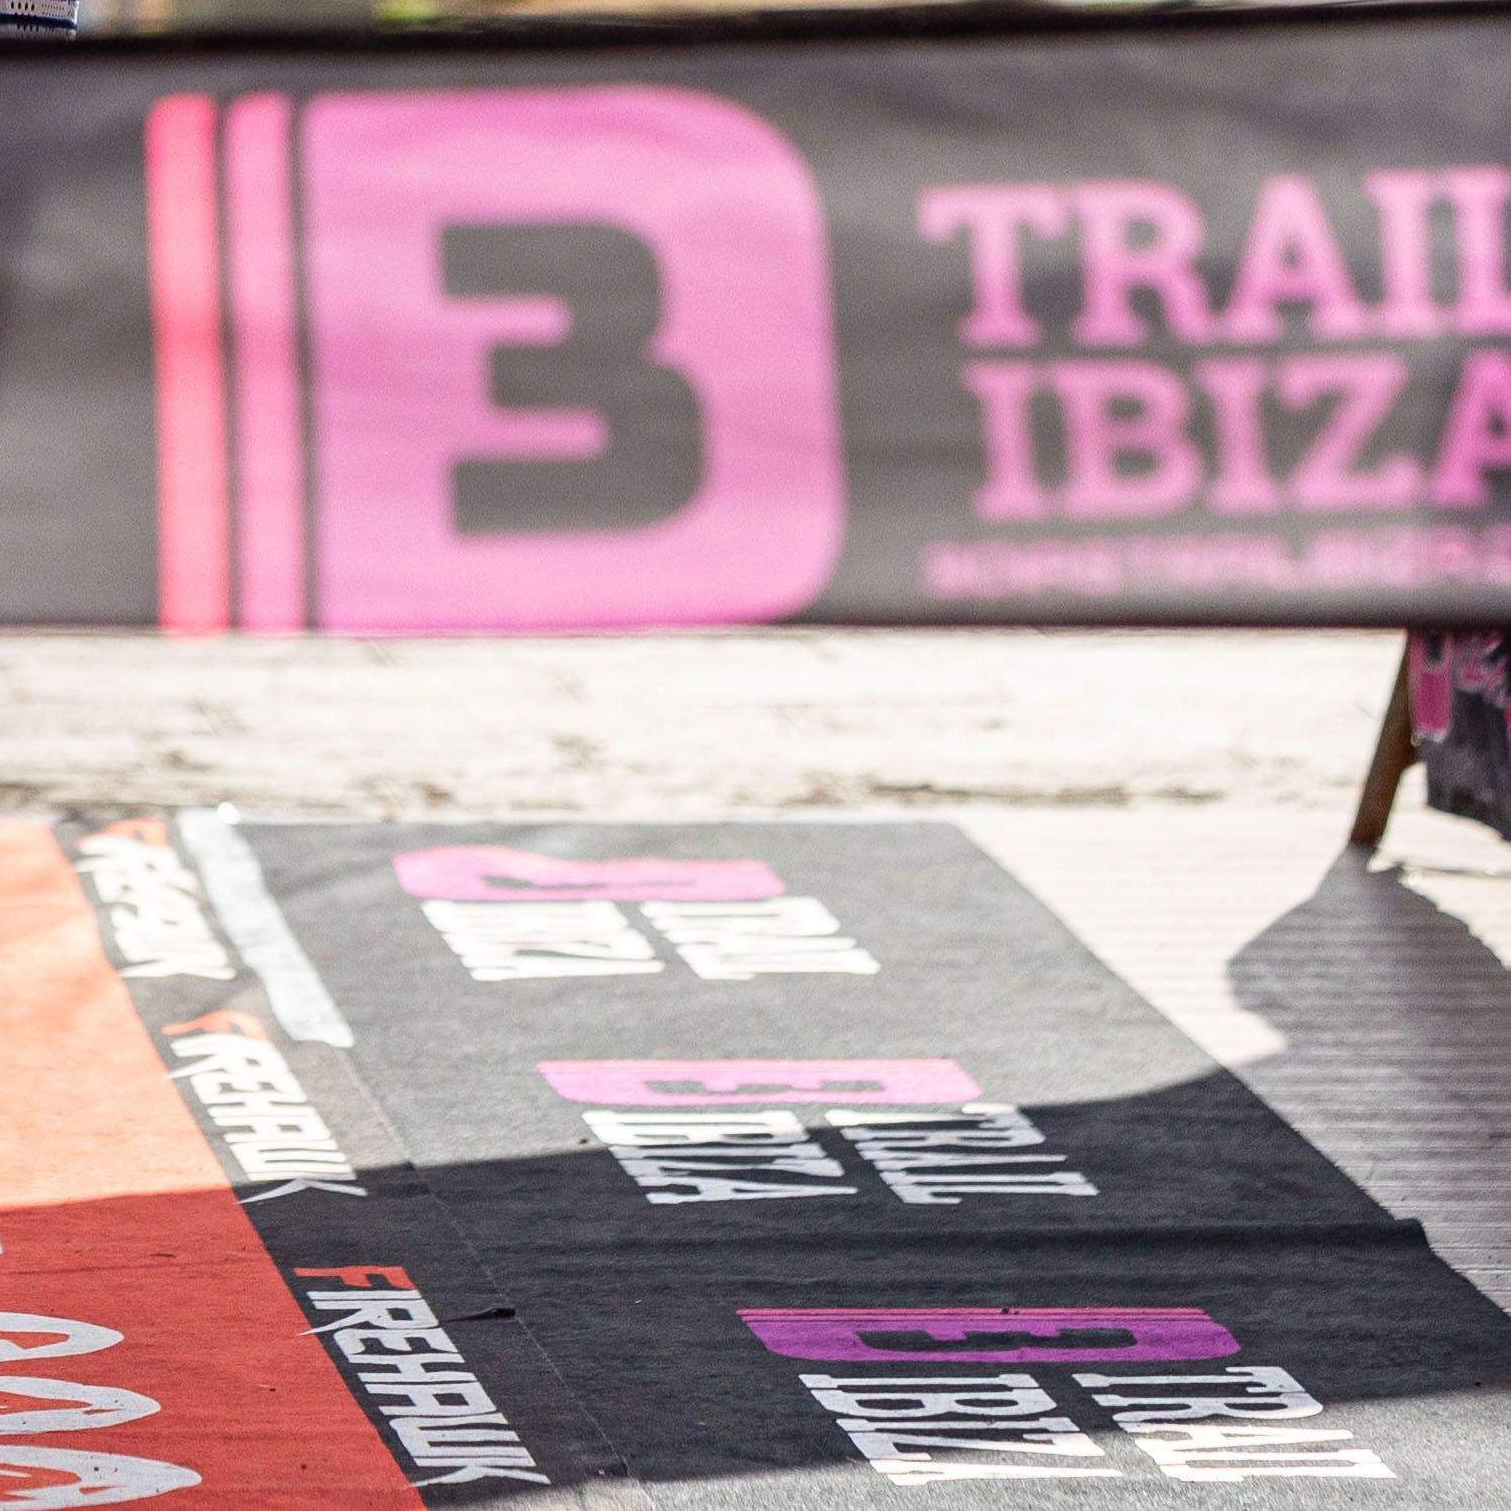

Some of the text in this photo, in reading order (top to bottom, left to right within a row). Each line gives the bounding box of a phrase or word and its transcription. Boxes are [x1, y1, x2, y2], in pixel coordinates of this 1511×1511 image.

[961, 347, 1511, 520] IBIZA
[161, 1010, 369, 1205] FIREHAWK
[582, 1109, 858, 1205] IBIZA
[826, 1102, 1098, 1205] TRAIL
[293, 1266, 552, 1490] FIREHAWK
[798, 1373, 1122, 1487] IBIZA
[1071, 1366, 1396, 1483] TRAIL
